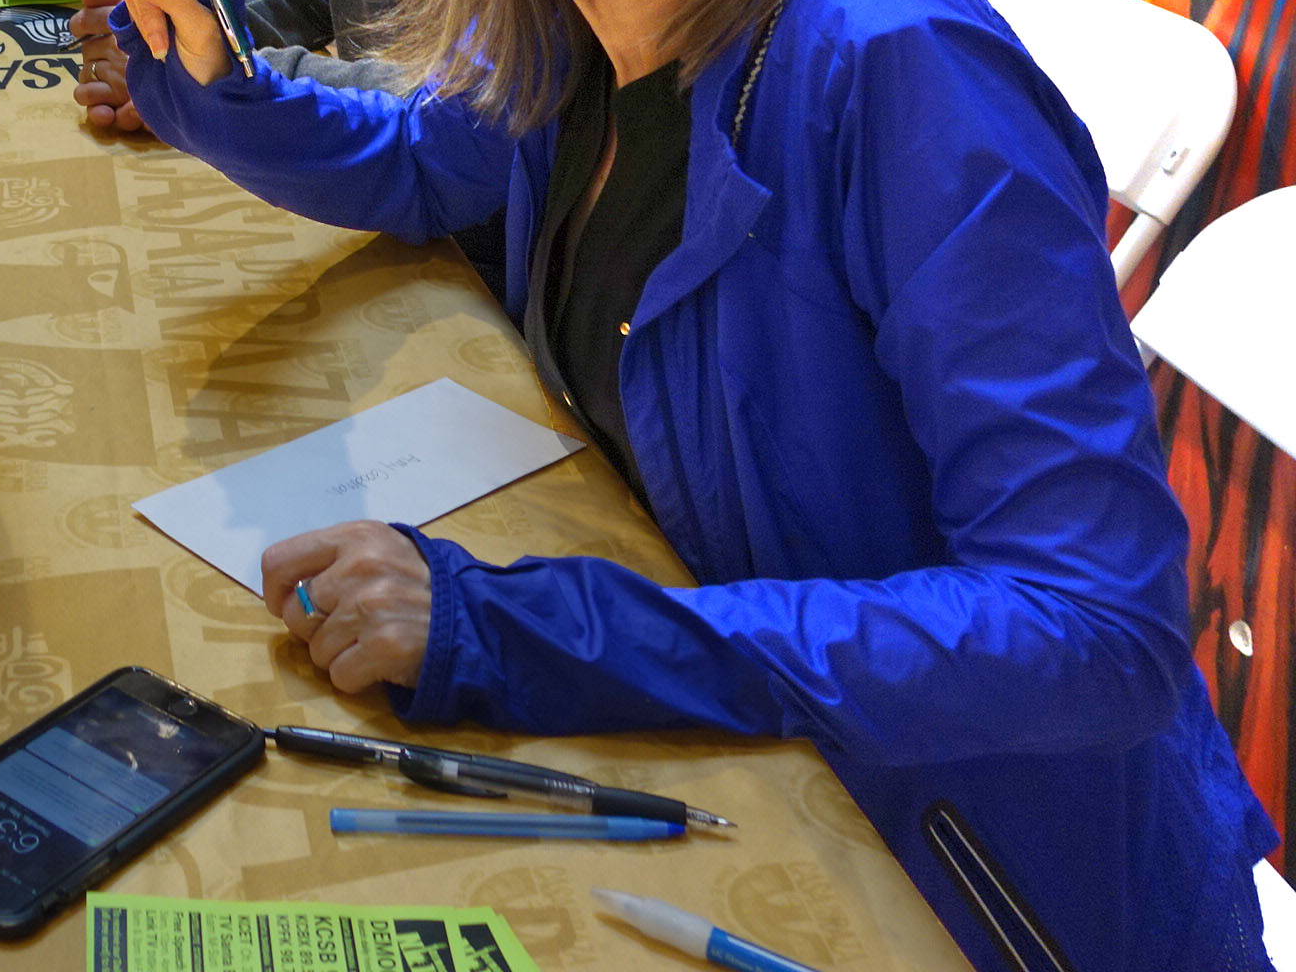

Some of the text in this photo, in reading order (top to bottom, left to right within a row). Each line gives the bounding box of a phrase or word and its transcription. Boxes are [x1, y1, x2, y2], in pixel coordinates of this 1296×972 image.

[154, 292, 352, 459] RAZA
[218, 914, 235, 967] TV Santa
[238, 914, 253, 946] KCET
[314, 915, 338, 964] KCSB
[369, 919, 397, 972] DEMO
